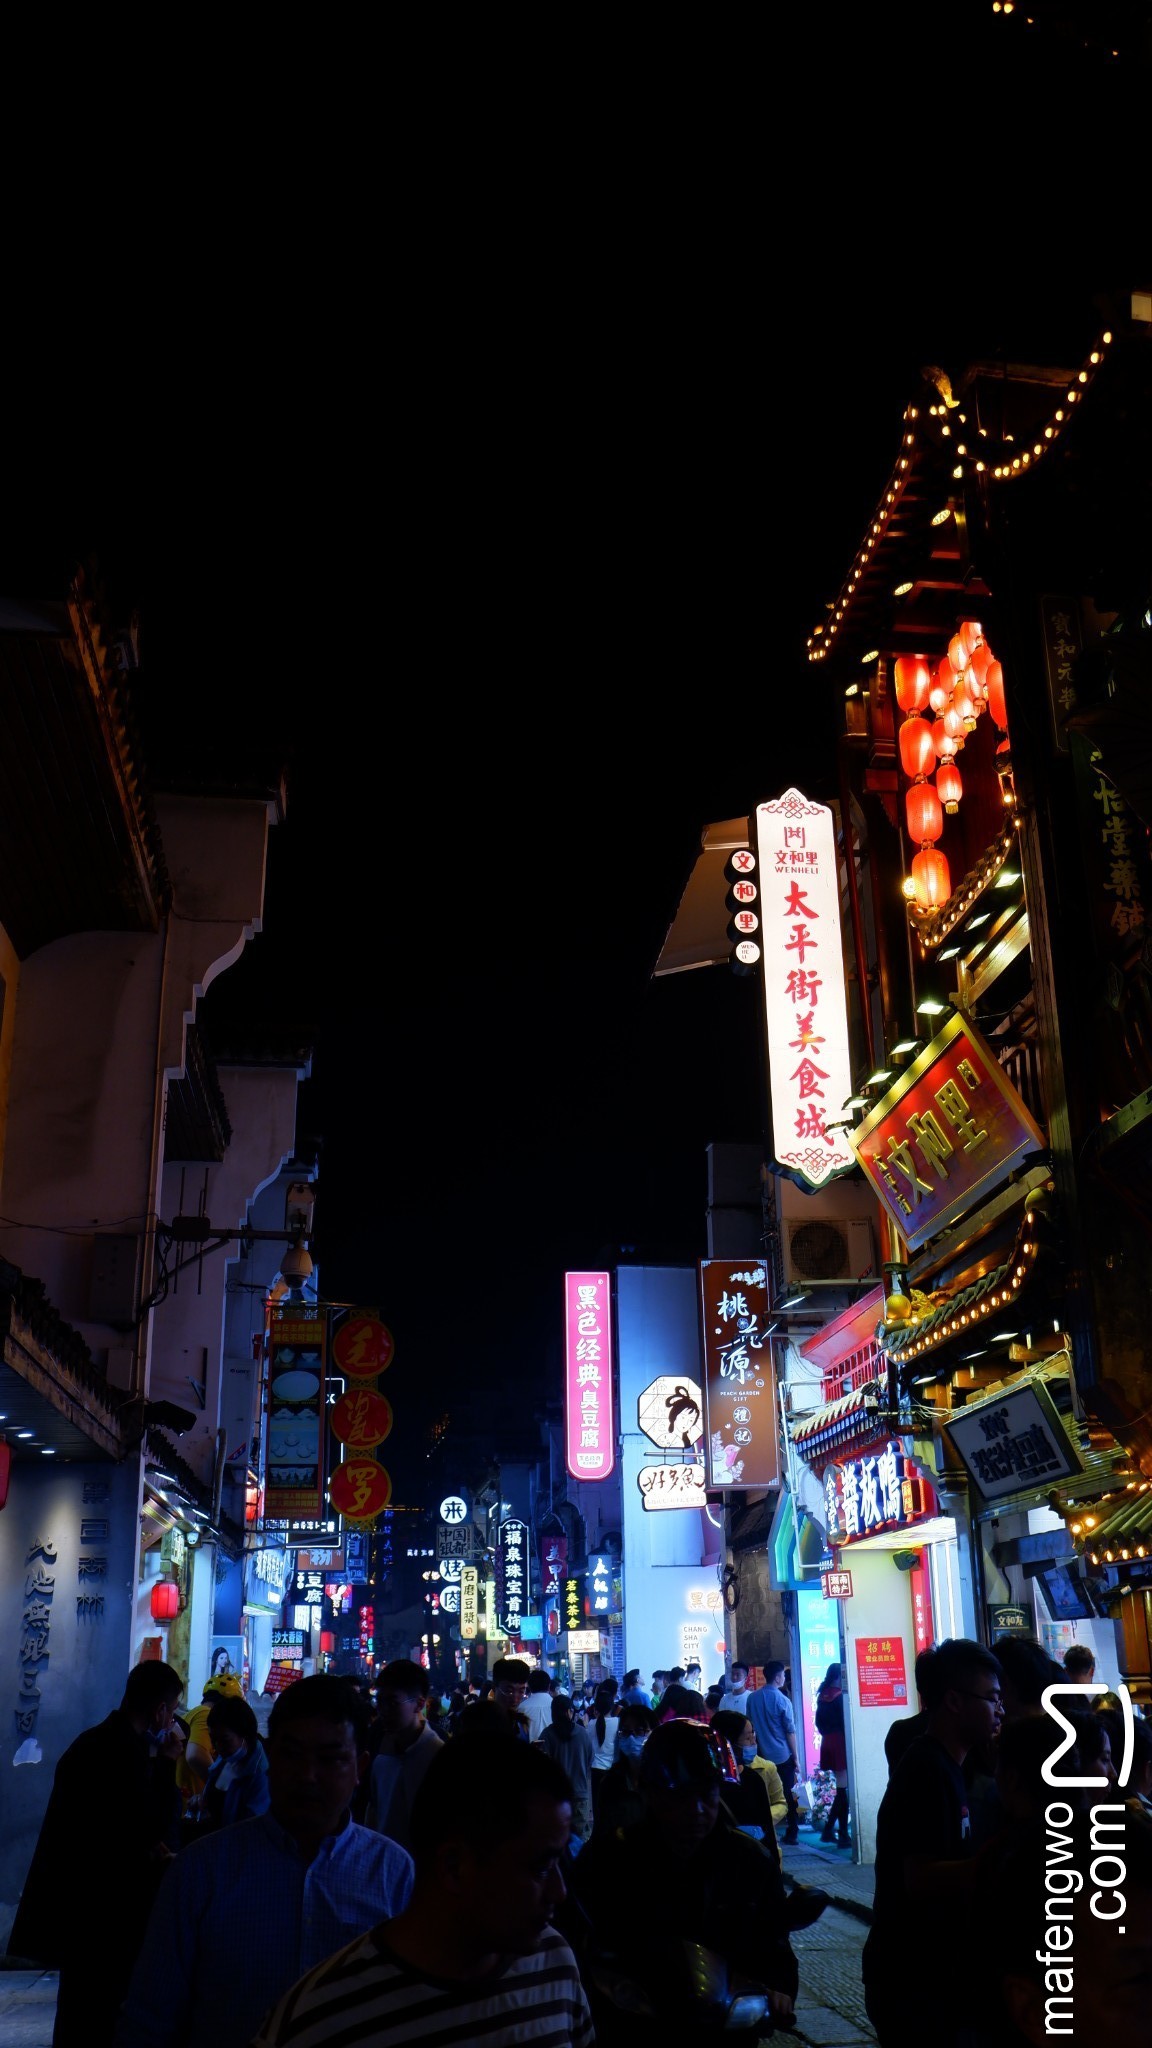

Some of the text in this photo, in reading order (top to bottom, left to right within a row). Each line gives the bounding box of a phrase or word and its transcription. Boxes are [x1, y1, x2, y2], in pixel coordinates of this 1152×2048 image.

[774, 850, 818, 866] 文和里
[775, 866, 819, 874] WENHELI
[735, 853, 754, 929] 文和里
[782, 880, 834, 1147] 太平街美食城
[887, 1079, 989, 1206] 文和里
[575, 1285, 602, 1449] 黑色经典臭豆腐
[304, 1571, 324, 1603] 豆腐
[504, 1531, 523, 1629] 福泉珠宝首饰
[867, 1642, 892, 1654] 招聘
[997, 1615, 1024, 1627] 文和友
